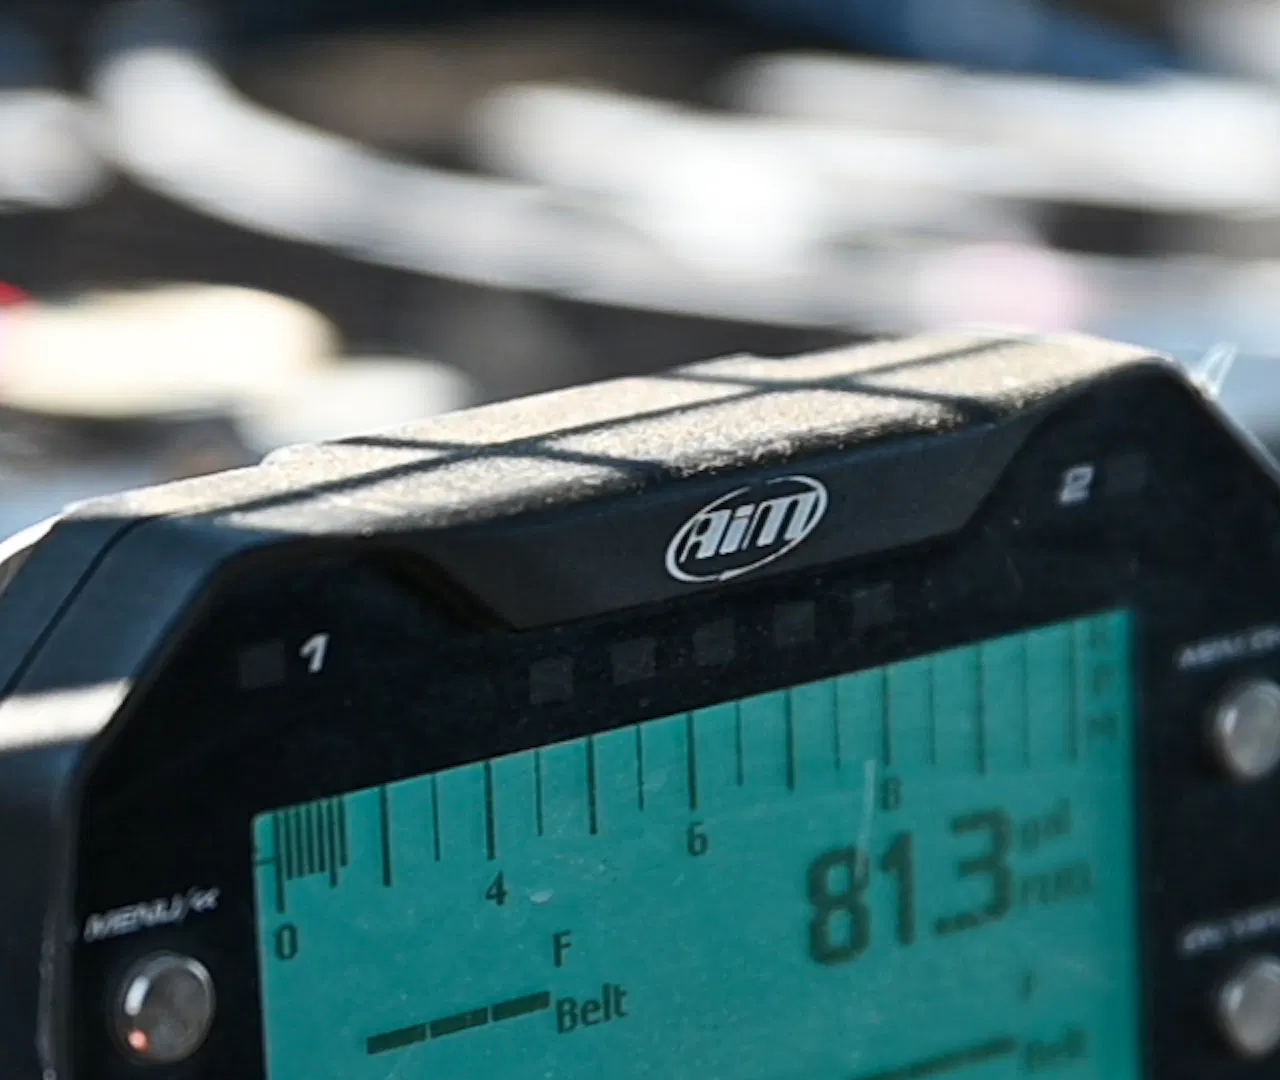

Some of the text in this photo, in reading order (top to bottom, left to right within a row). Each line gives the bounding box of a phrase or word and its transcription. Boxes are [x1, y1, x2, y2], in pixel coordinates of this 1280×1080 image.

[1060, 465, 1094, 505] 2
[299, 632, 329, 673] 1
[685, 821, 708, 857] 6
[485, 870, 508, 906] 4
[275, 923, 298, 961] 0
[553, 930, 573, 968] F
[556, 982, 629, 1035] Belt
